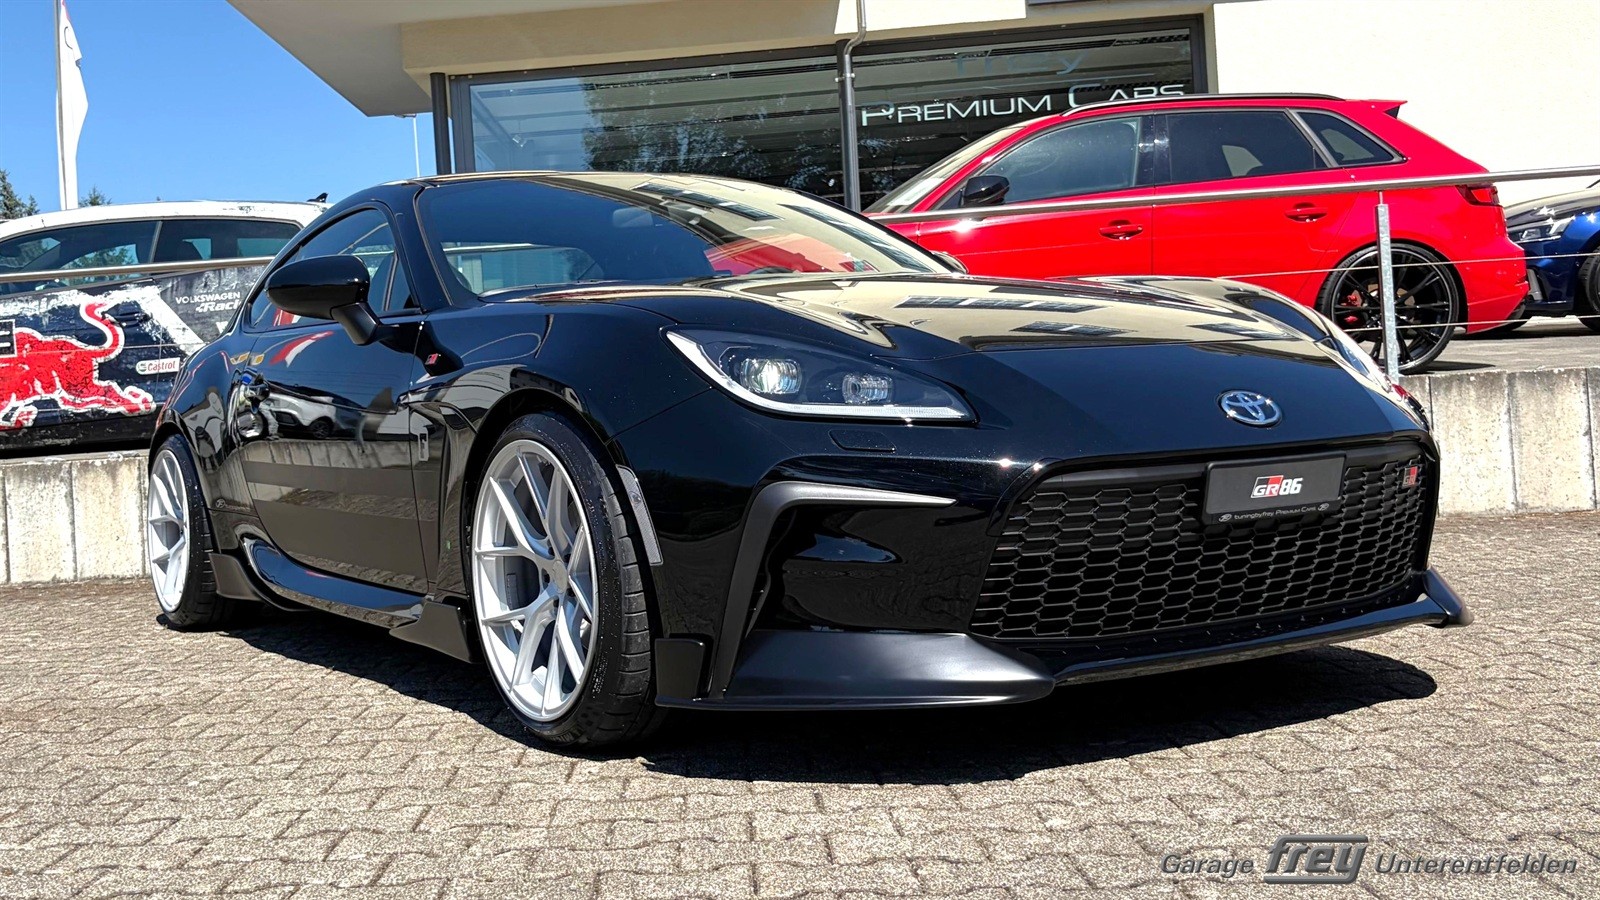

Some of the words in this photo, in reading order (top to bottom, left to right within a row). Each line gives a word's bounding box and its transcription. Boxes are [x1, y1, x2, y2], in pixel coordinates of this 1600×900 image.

[862, 95, 1052, 127] PREMIUM
[175, 291, 241, 304] VOLKSWAGEN
[147, 361, 176, 371] Castrol
[1252, 478, 1304, 496] GR86
